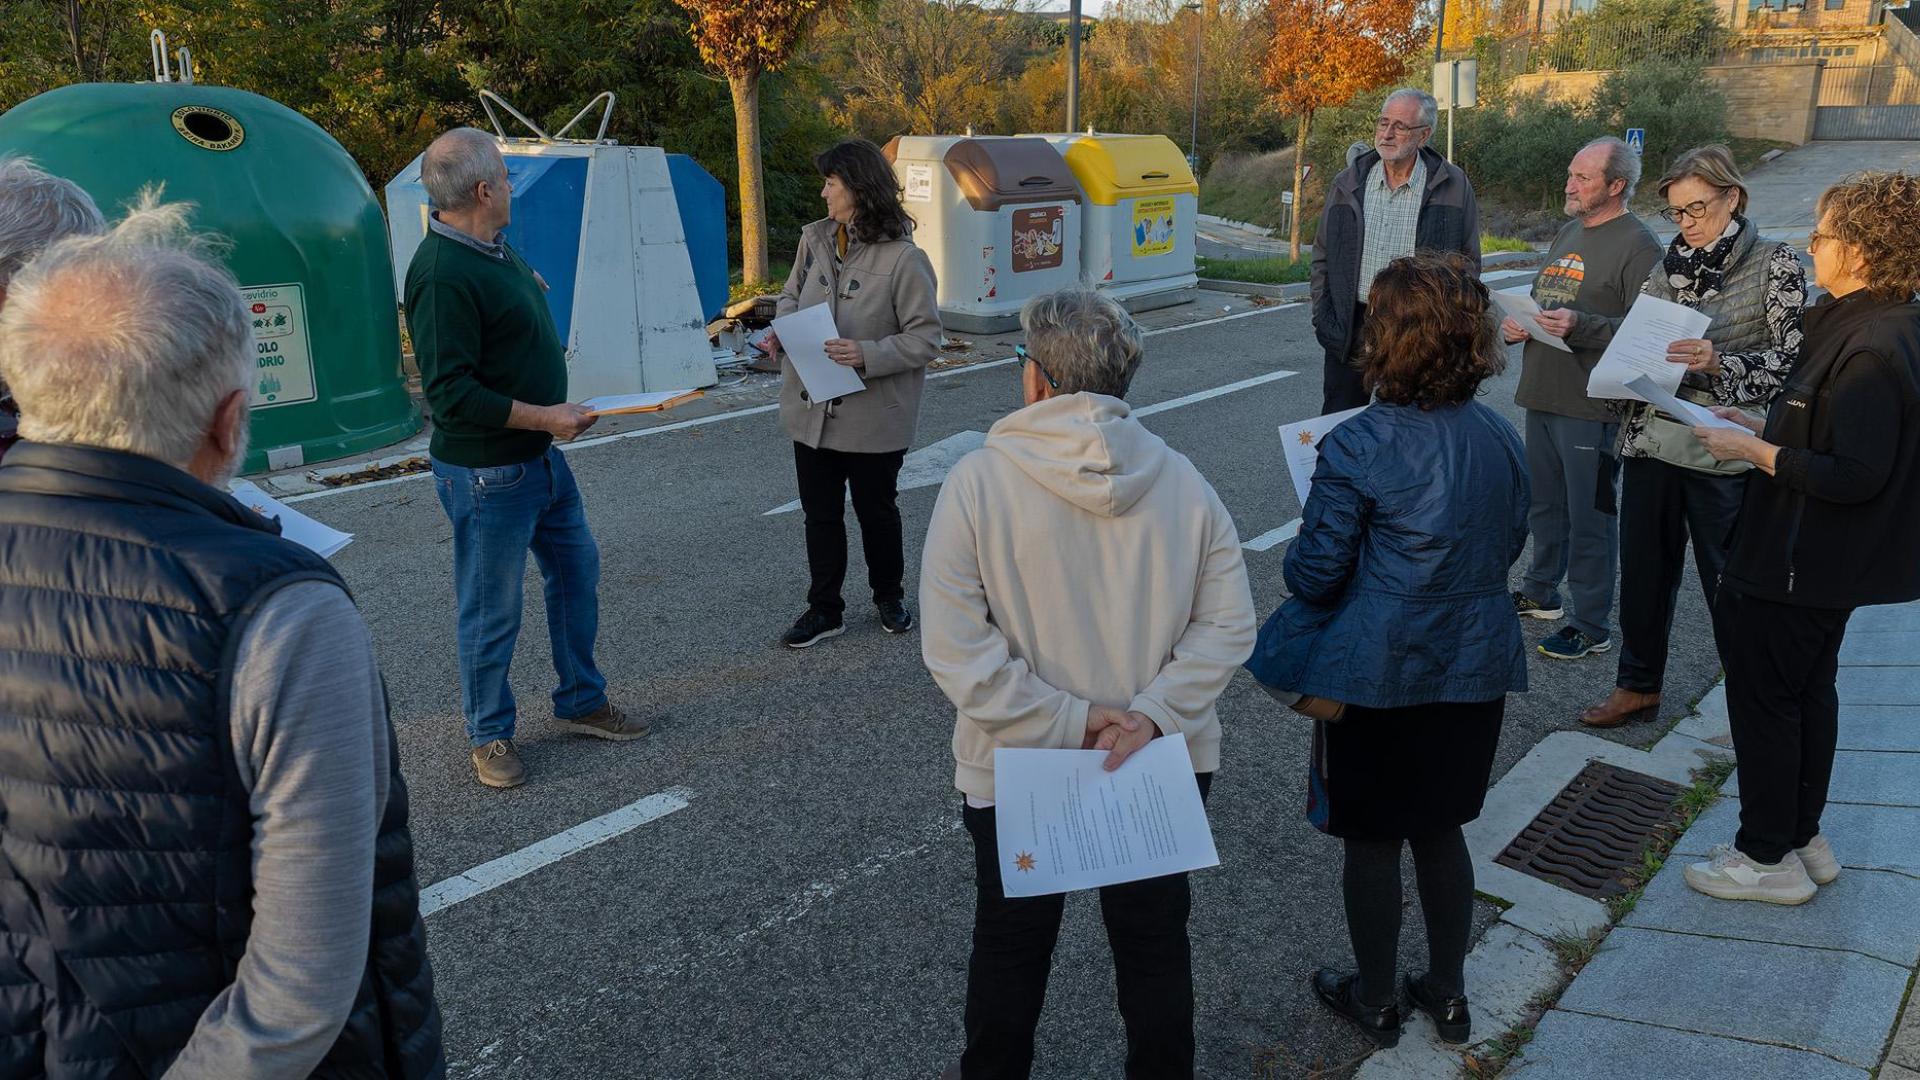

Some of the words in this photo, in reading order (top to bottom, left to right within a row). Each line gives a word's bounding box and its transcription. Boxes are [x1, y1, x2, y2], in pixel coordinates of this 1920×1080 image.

[174, 106, 195, 119] SOLO
[242, 288, 278, 300] covidrio
[257, 341, 279, 353] OLO
[256, 355, 285, 368] IDRIO
